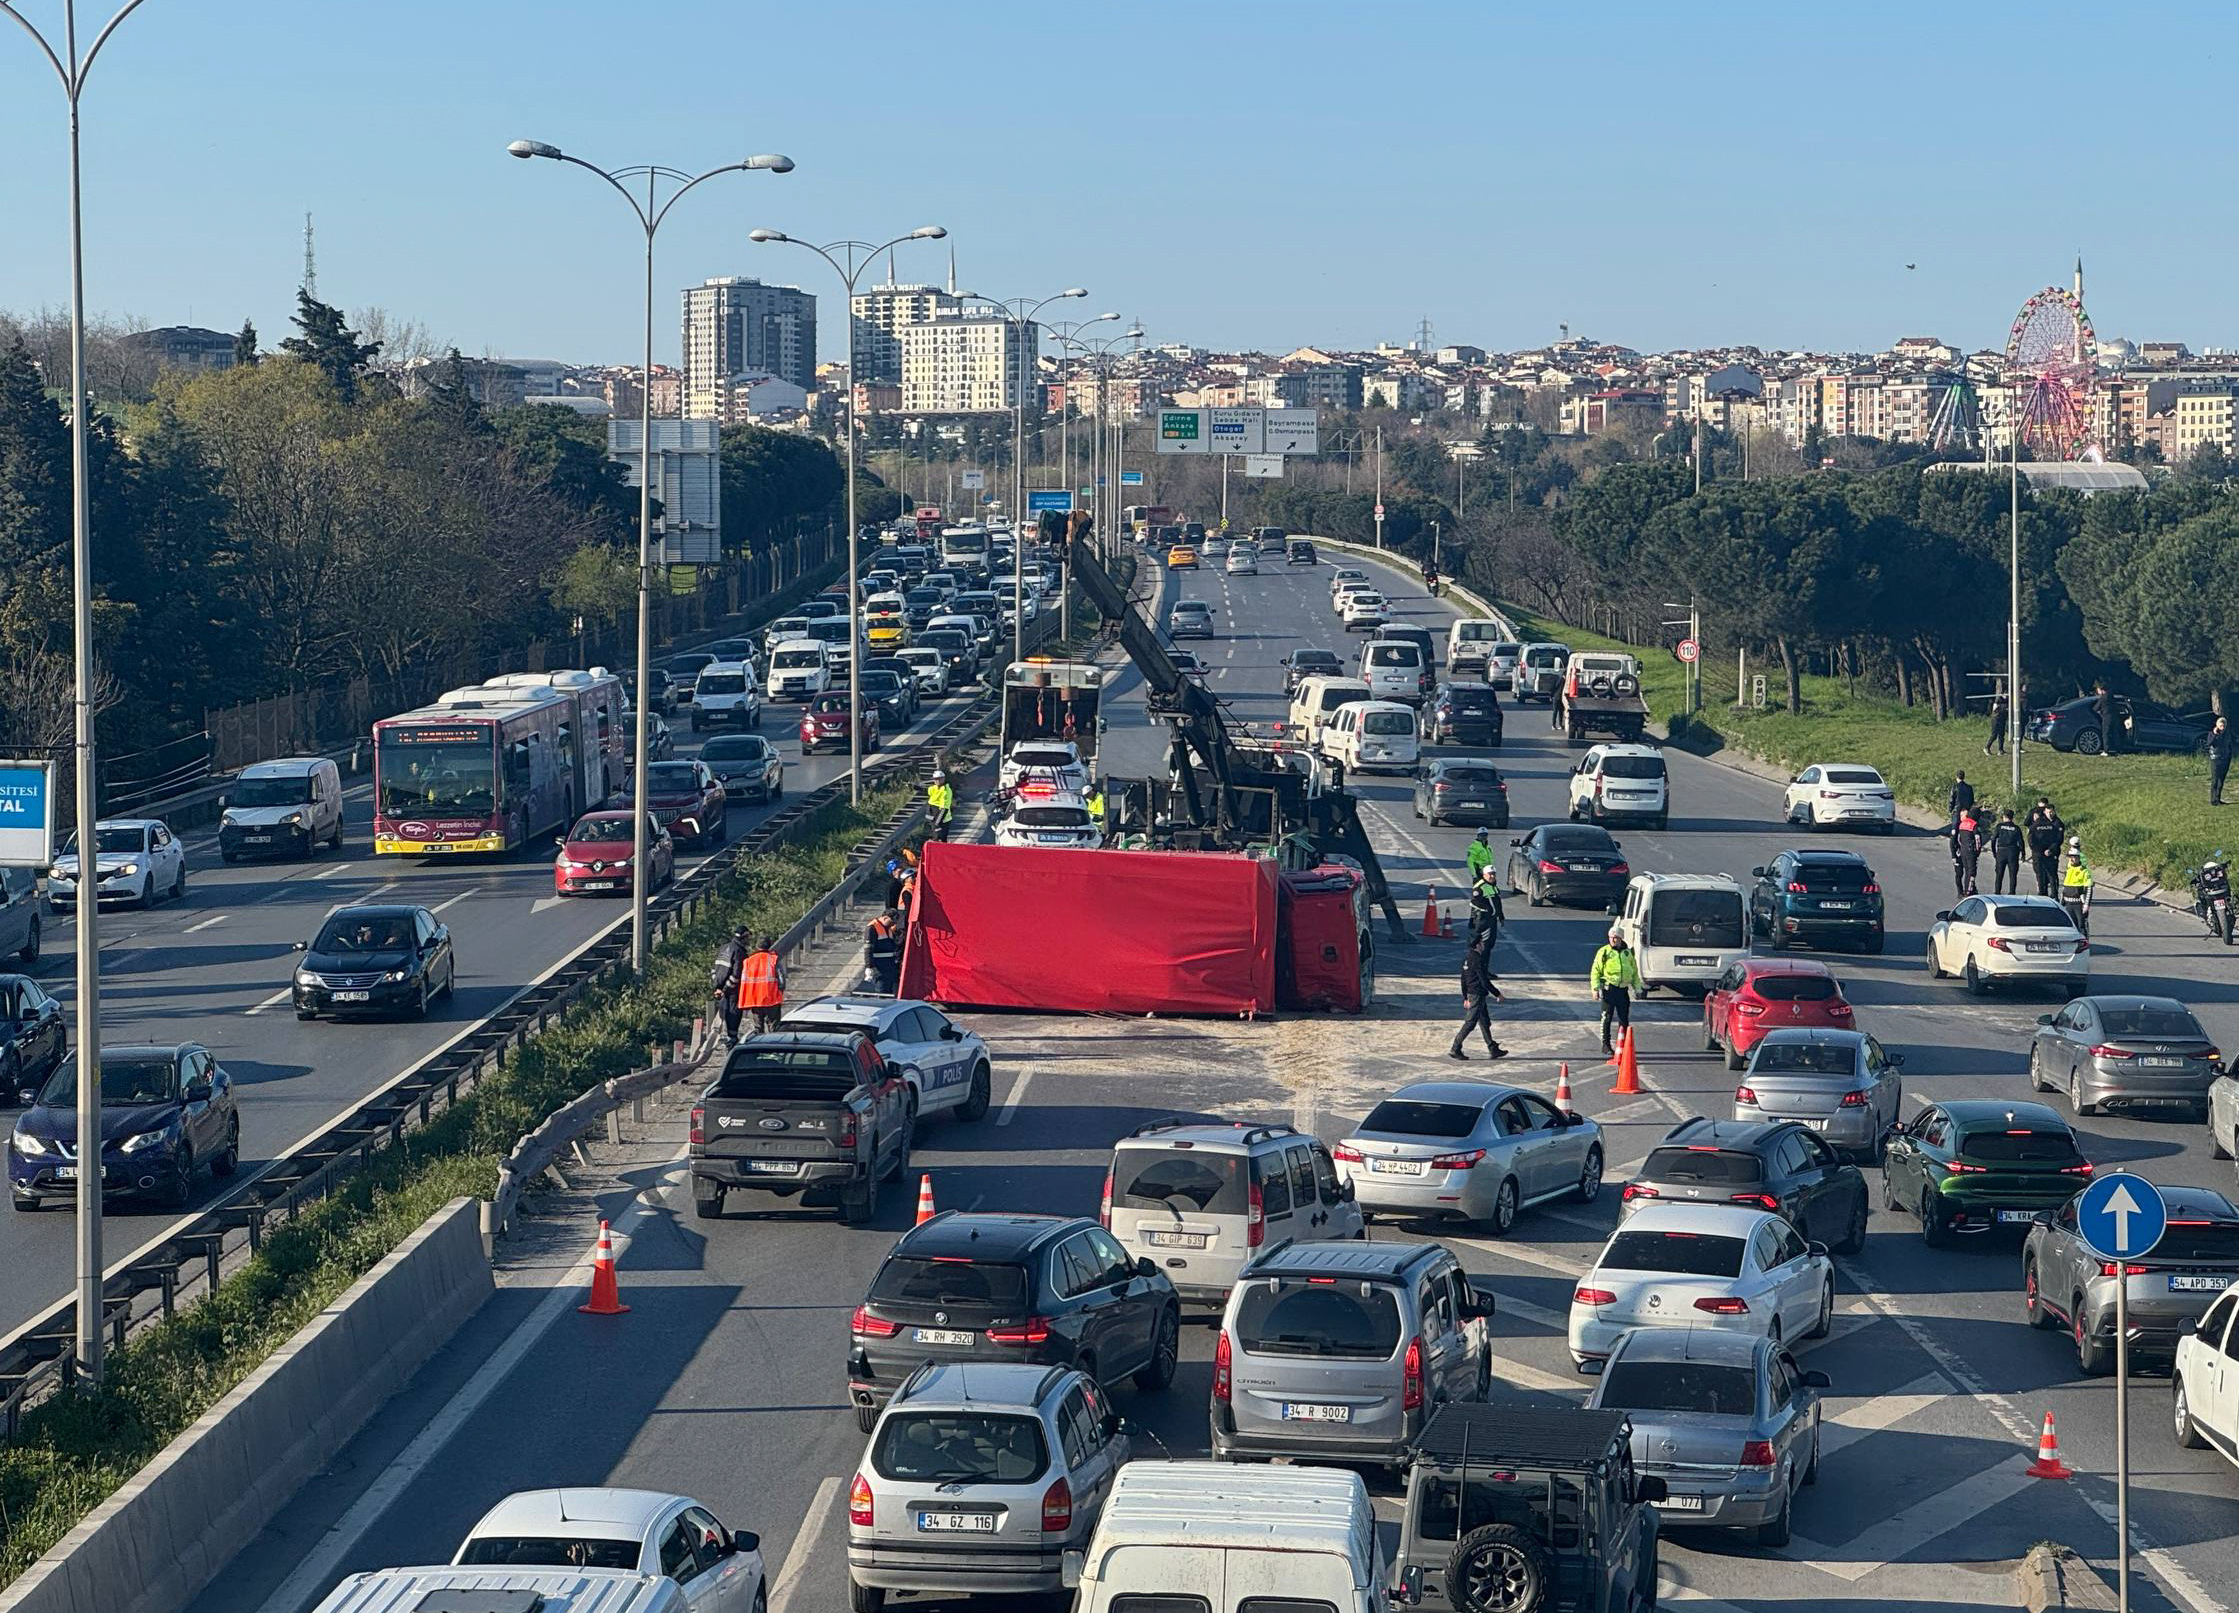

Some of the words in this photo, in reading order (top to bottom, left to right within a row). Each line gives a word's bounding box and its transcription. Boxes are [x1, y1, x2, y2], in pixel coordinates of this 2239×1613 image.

[1682, 646, 1694, 655] 110
[61, 1168, 69, 1176] 34
[2003, 1212, 2012, 1220] 34
[1156, 1234, 1165, 1243] 34
[1187, 1236, 1203, 1245] 639
[2174, 1278, 2185, 1288] 54
[2210, 1279, 2226, 1288] 353
[918, 1331, 928, 1340] 34
[934, 1332, 945, 1342] RH
[951, 1332, 973, 1344] 3920
[1289, 1405, 1300, 1416] 34
[1308, 1406, 1314, 1416] R
[1322, 1407, 1346, 1418] 9002
[1682, 1496, 1700, 1507] 077
[926, 1516, 939, 1527] 34
[950, 1517, 963, 1528] GZ
[975, 1517, 991, 1529] 116
